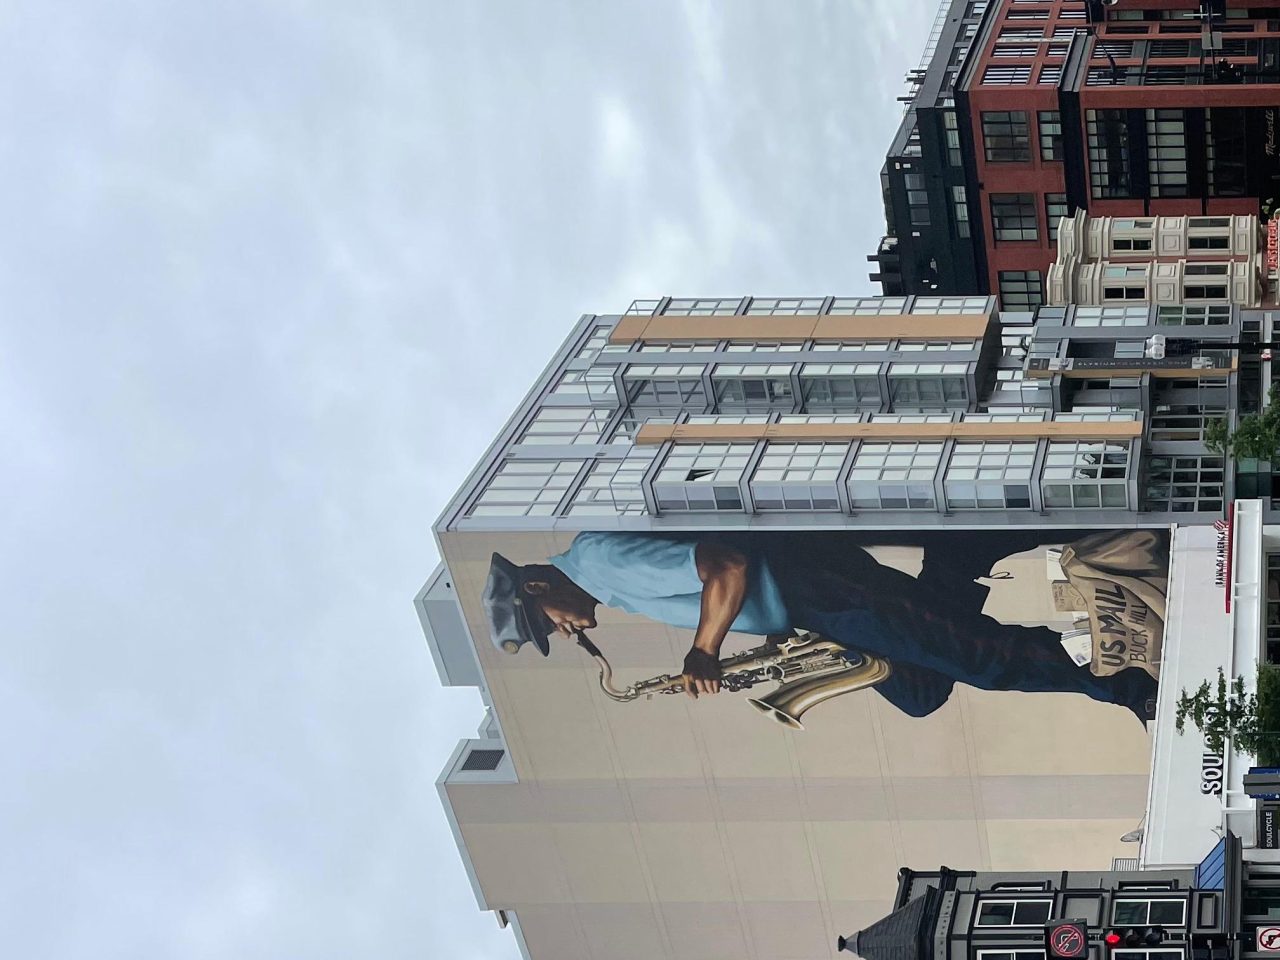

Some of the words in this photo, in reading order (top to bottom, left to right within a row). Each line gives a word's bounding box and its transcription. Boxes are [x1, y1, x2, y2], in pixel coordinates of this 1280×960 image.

[1216, 531, 1225, 558] AMERICA
[1215, 568, 1224, 585] BANK
[1094, 584, 1127, 637] MAIL
[1127, 600, 1148, 627] HILL
[1099, 640, 1127, 667] US
[1129, 628, 1149, 664] BUCK
[1265, 811, 1273, 848] SOULCYCLE
